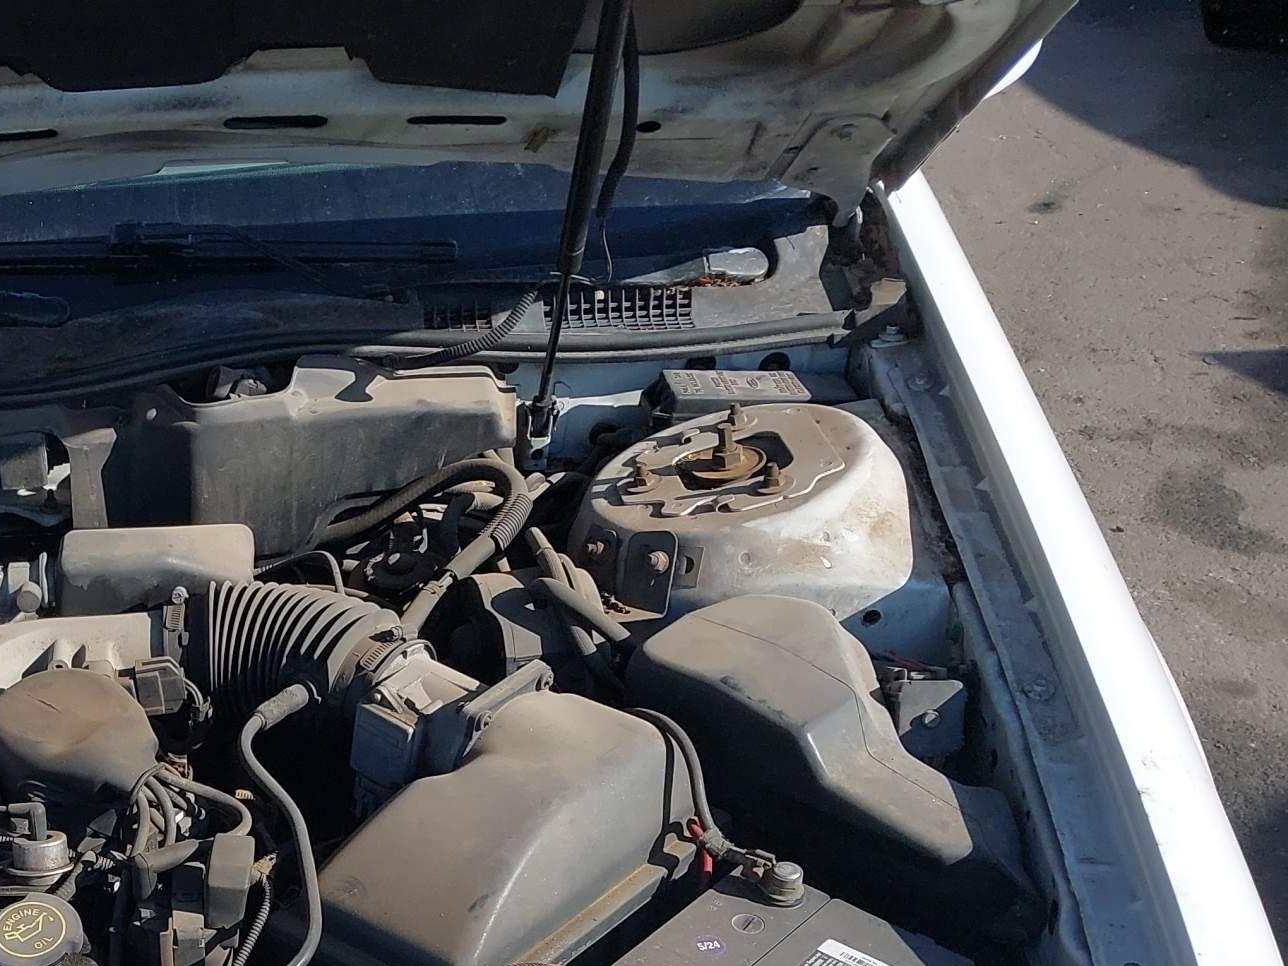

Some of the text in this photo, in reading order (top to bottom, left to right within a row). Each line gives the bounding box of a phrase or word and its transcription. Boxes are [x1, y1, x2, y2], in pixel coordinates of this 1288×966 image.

[3, 908, 41, 931] ENGINE
[34, 936, 54, 949] OIL
[697, 940, 720, 951] 5/24
